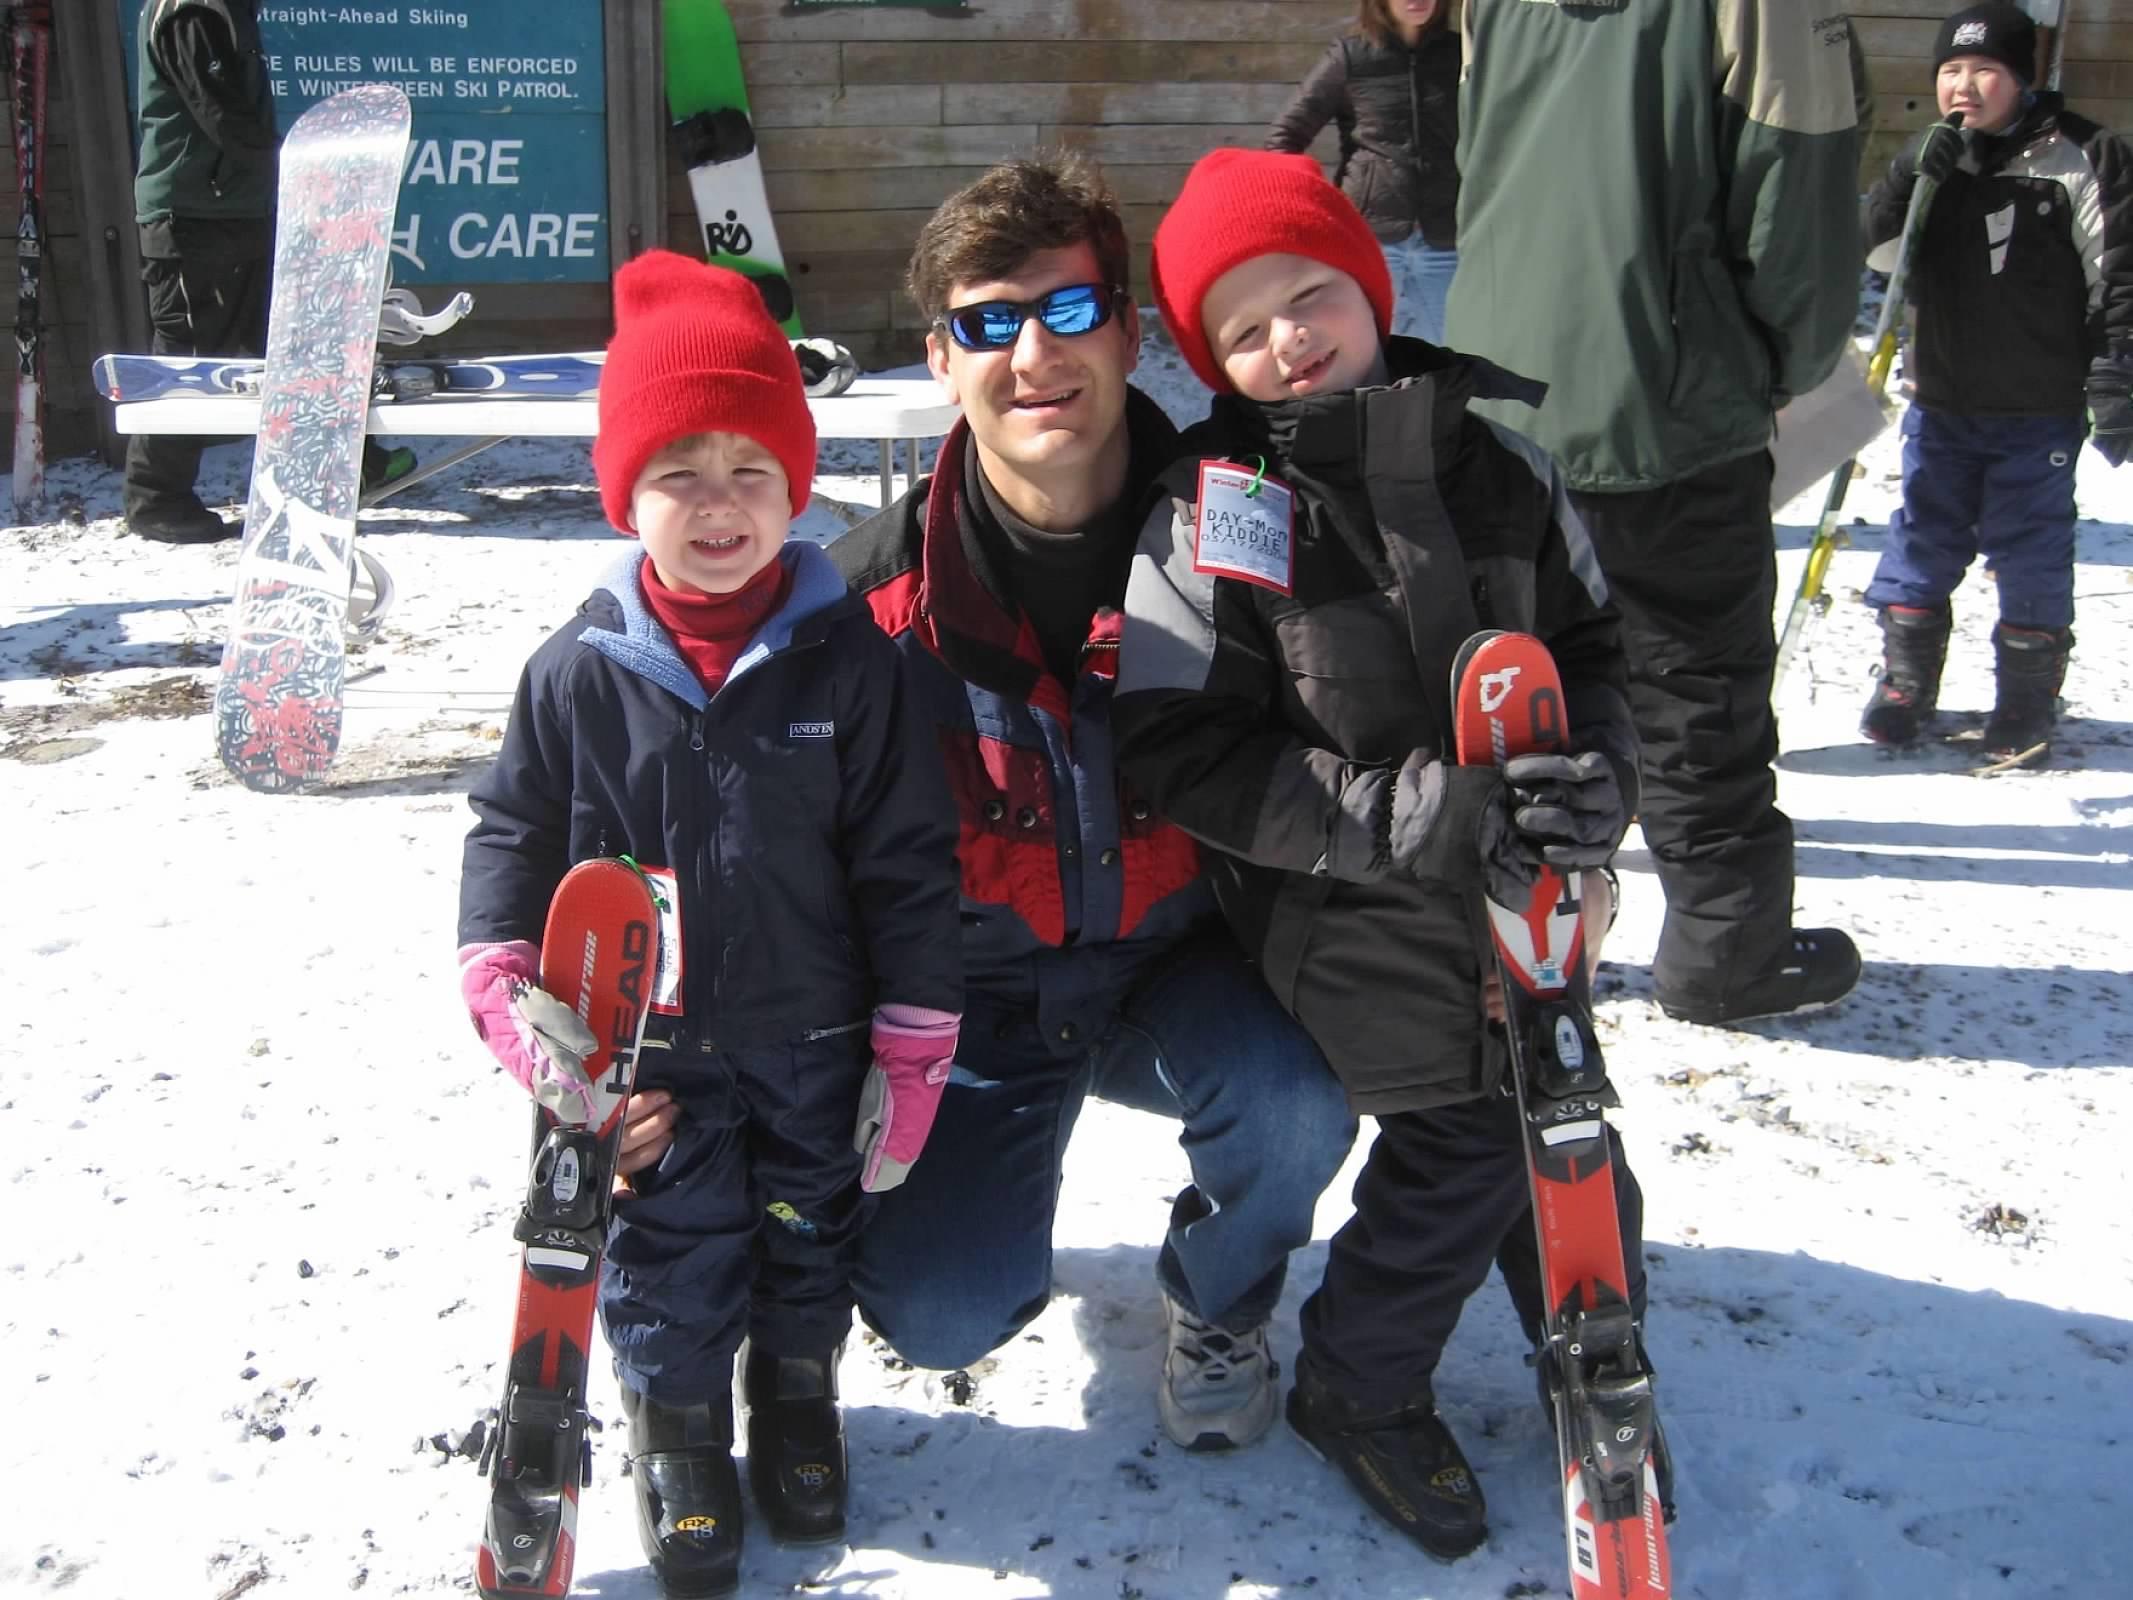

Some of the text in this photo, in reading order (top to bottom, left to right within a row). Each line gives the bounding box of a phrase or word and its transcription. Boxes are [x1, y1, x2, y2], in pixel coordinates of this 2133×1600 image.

[257, 8, 468, 29] traight-Ahead Skiing
[295, 56, 362, 72] RULES
[372, 57, 420, 73] WILL
[430, 57, 457, 73] BE
[467, 58, 578, 74] ENFORCED
[299, 79, 443, 97] WINTEEN
[455, 80, 488, 98] SKI
[498, 80, 579, 98] PATROL.
[449, 212, 600, 259] CARE
[1212, 523, 1281, 551] KIDDIE
[605, 919, 649, 1094] HEAD
